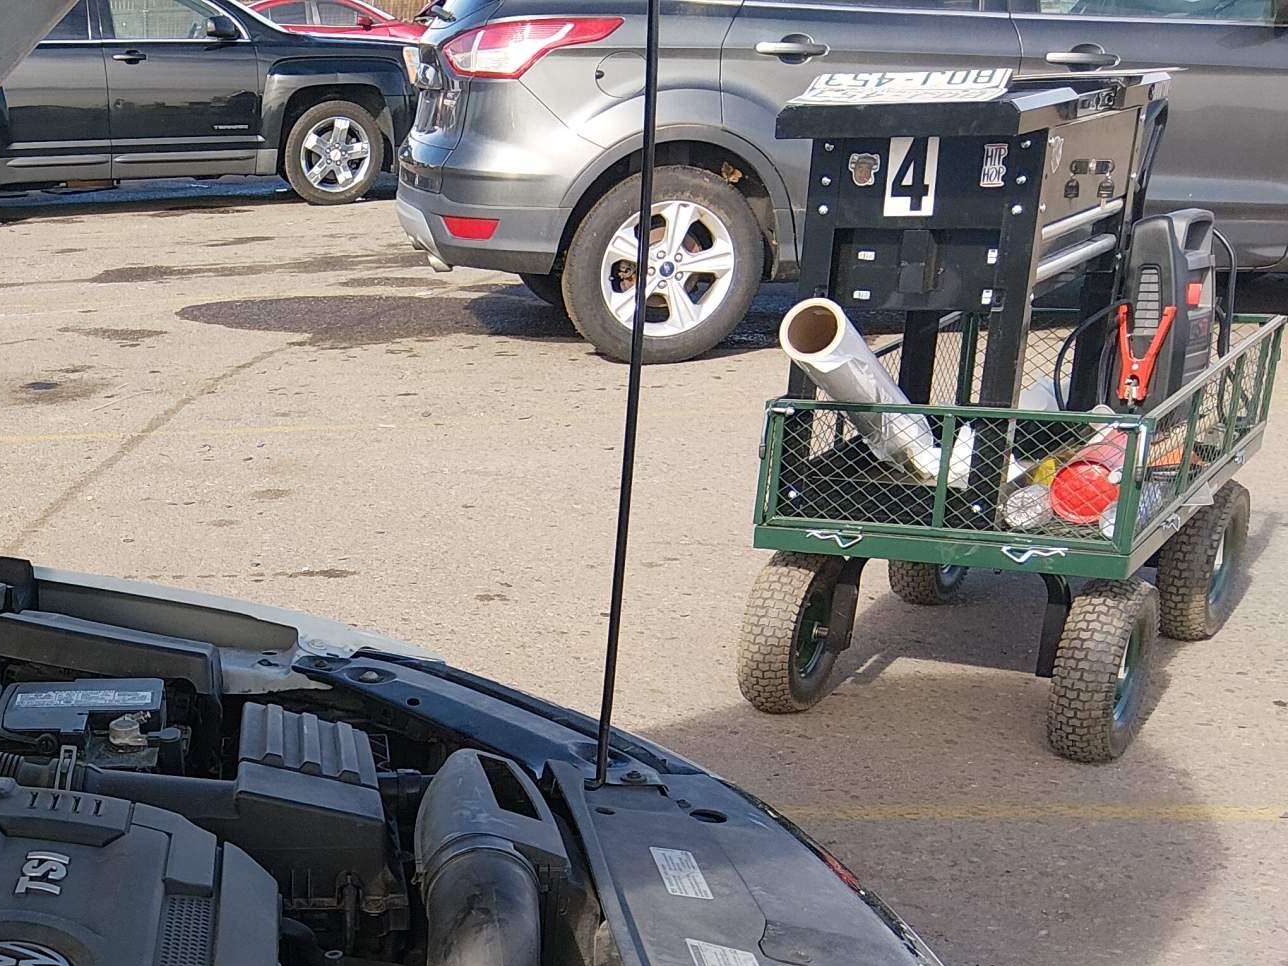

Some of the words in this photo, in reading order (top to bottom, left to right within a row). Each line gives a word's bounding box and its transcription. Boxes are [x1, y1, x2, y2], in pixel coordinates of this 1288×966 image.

[984, 147, 1007, 166] HIP
[891, 136, 929, 211] 4
[982, 166, 1005, 182] HOP
[15, 851, 71, 896] TSI
